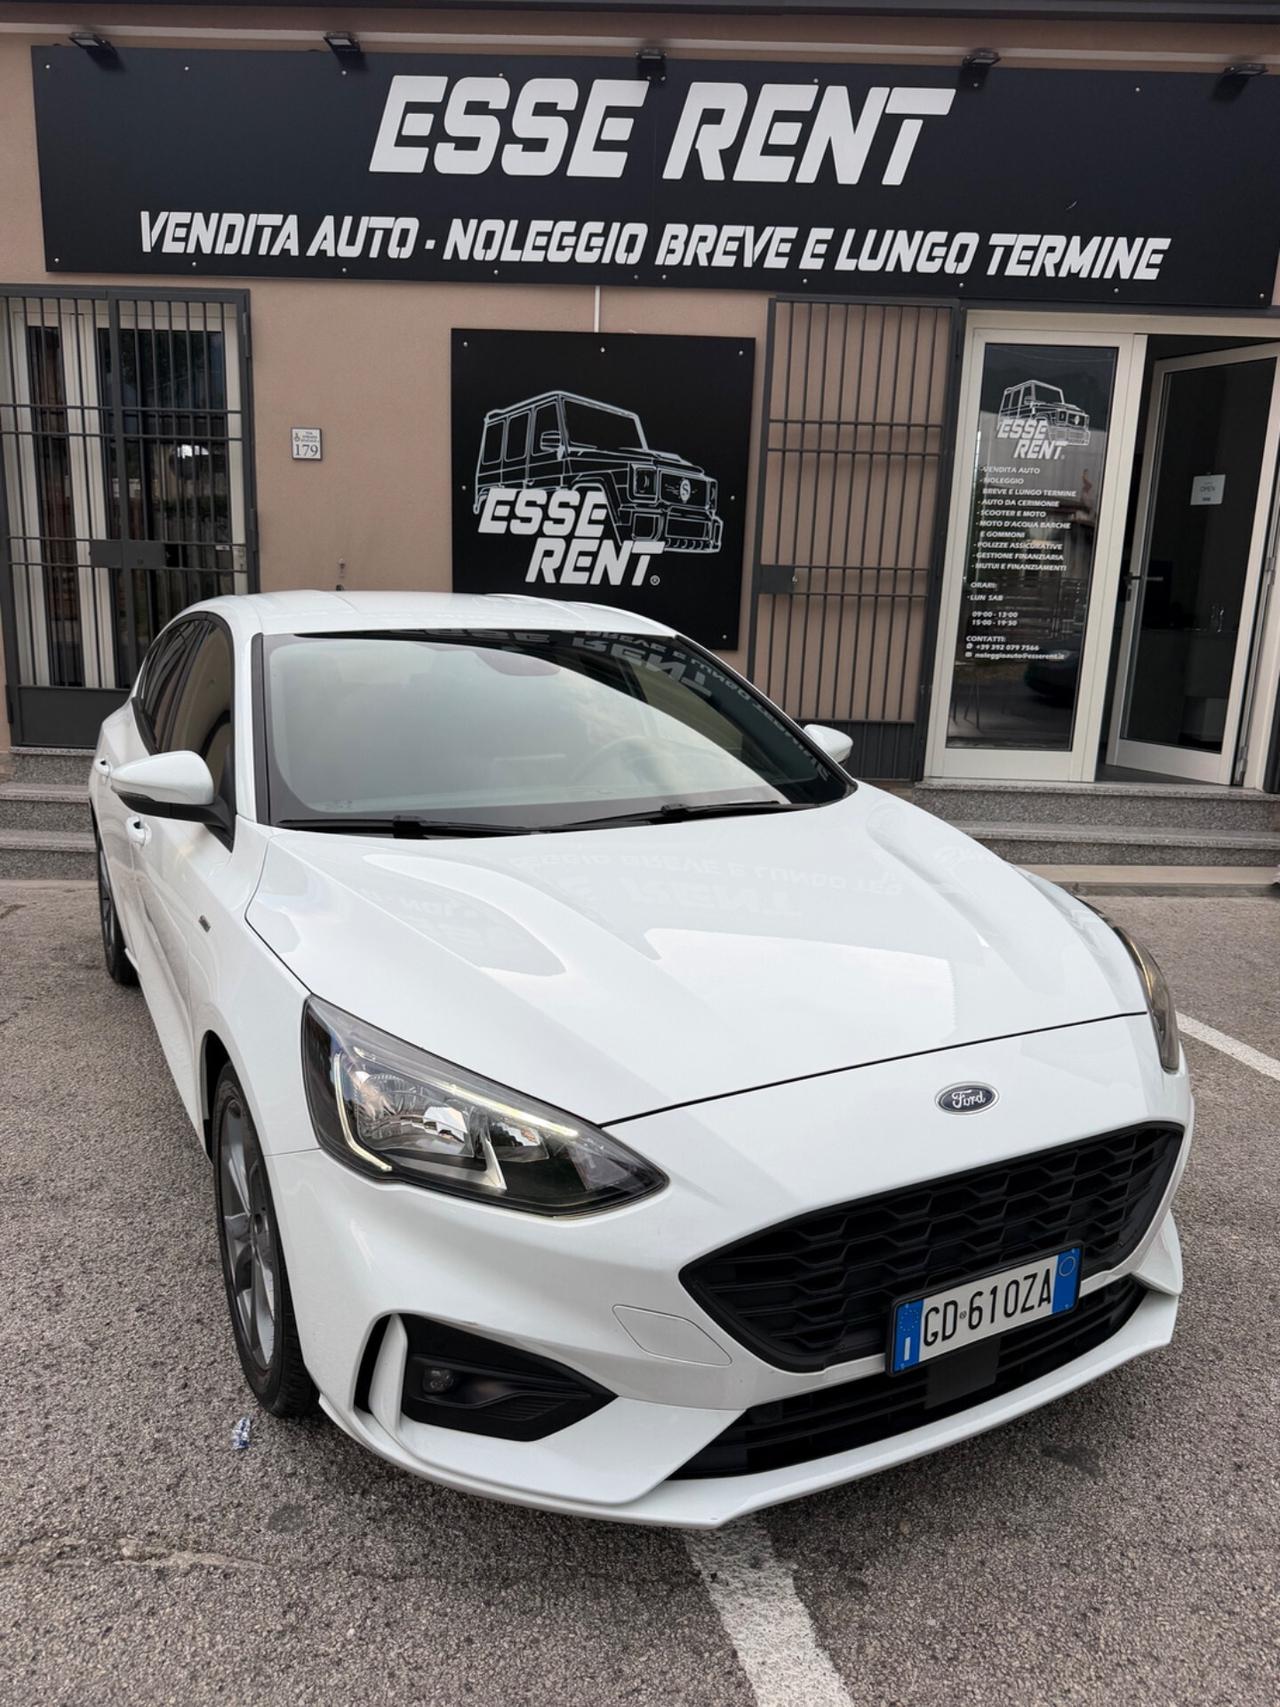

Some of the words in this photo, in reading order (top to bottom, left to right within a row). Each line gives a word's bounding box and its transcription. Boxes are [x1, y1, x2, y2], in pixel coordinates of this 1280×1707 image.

[369, 75, 649, 178] ESSE
[663, 82, 957, 186] RENT
[140, 211, 299, 256] VENDITA
[306, 215, 420, 260] AUTO
[443, 219, 649, 267] NOLEGGIO
[655, 224, 798, 270] BREVE
[799, 228, 835, 270] E
[835, 229, 979, 275] LUNGO
[987, 234, 1172, 281] TERMINE
[997, 419, 1048, 439] ESSE
[296, 444, 318, 457] 179
[478, 487, 608, 538] ESSE
[951, 1089, 986, 1109] Ford
